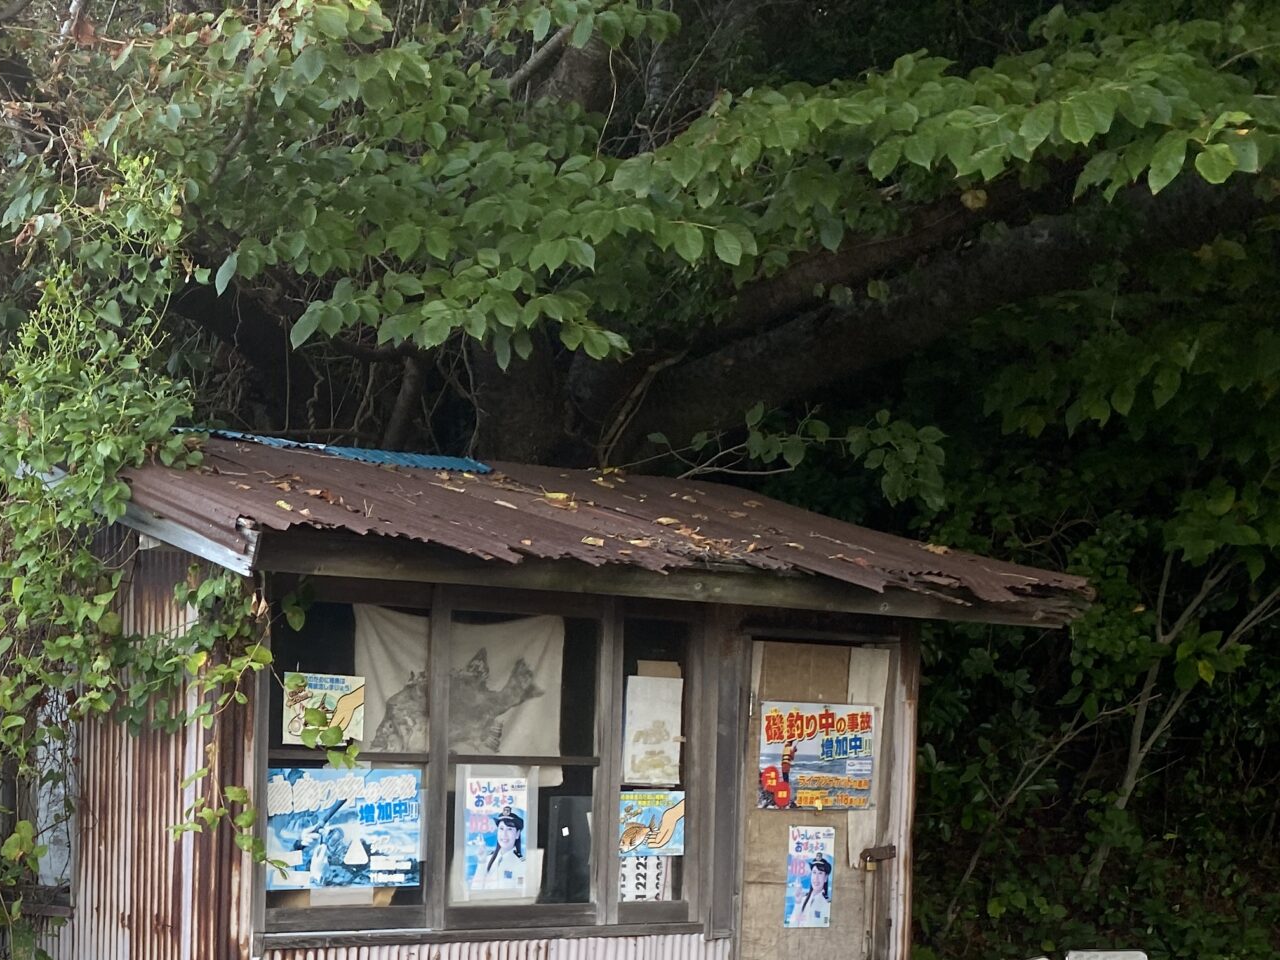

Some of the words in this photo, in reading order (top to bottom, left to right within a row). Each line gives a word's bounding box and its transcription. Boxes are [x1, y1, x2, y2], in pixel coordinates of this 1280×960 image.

[765, 709, 871, 743] 磯釣り中の事故
[821, 735, 872, 759] 増加中!!
[470, 780, 508, 794] いっしょに
[359, 801, 419, 824] 増加中!!
[792, 829, 821, 841] いっしょに
